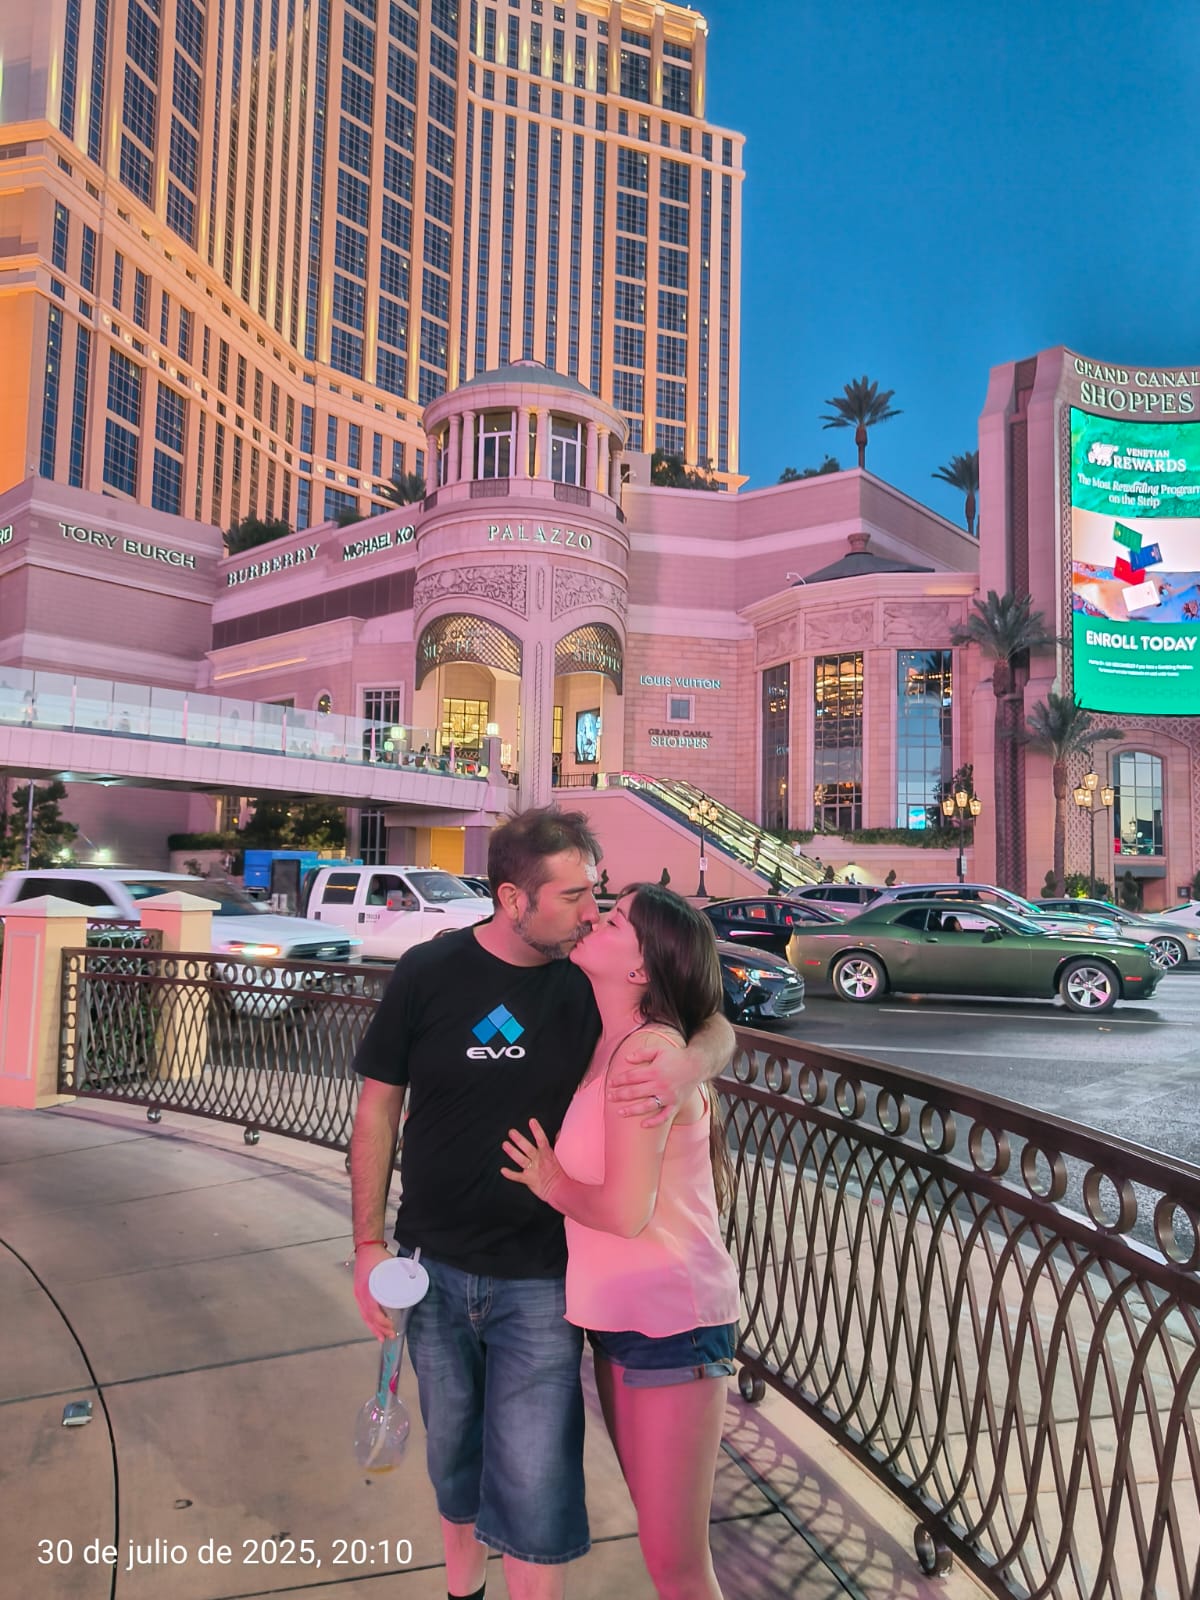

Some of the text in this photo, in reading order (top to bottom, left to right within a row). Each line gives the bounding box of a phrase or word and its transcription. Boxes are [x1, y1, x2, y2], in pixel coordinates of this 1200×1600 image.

[1074, 358, 1200, 387] GRAND CANAL
[1080, 380, 1195, 414] SHOPPES
[1113, 455, 1187, 472] REWARDS
[1126, 447, 1170, 458] VENETIAN
[1077, 472, 1092, 486] The
[1092, 477, 1111, 490] Most
[1112, 481, 1159, 496] Rewarding
[1109, 494, 1160, 509] on the Strip
[58, 522, 197, 570] TORY BURCH
[343, 524, 416, 562] MICHAEL KO
[488, 524, 593, 550] PALAZZO
[227, 543, 320, 588] BURBERRY
[1086, 629, 1198, 652] ENROLL TODAY
[640, 674, 721, 690] LOUIS VUITTON
[648, 728, 713, 739] GRAND CANAL
[650, 735, 709, 750] SHOPPES
[466, 1045, 526, 1060] EVO
